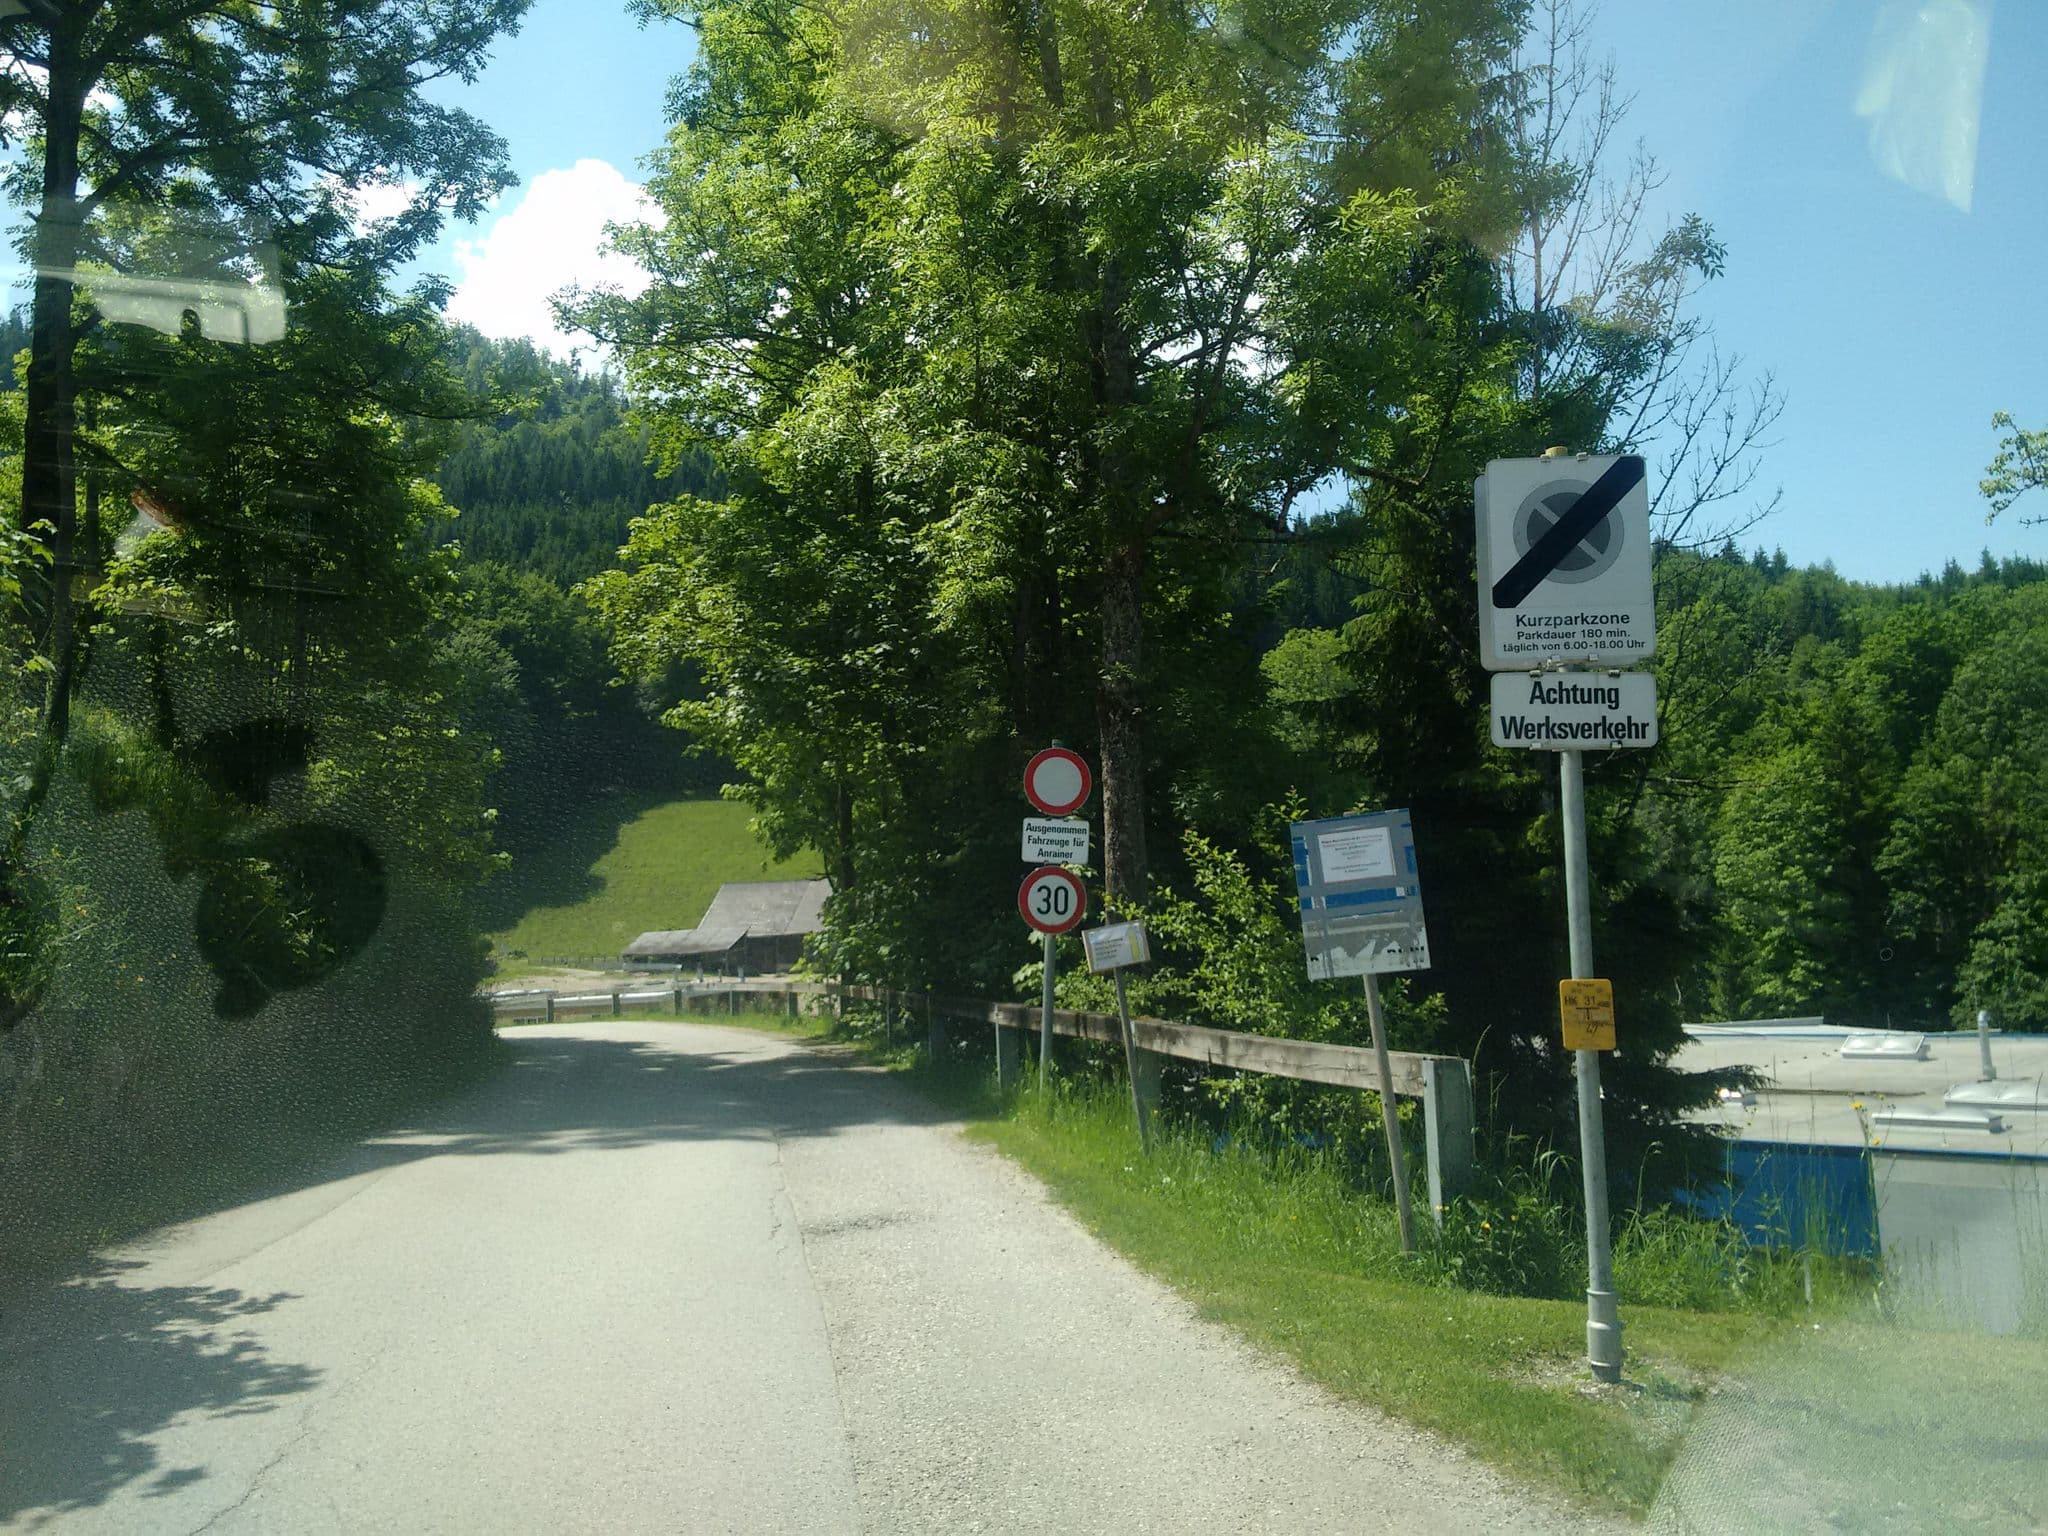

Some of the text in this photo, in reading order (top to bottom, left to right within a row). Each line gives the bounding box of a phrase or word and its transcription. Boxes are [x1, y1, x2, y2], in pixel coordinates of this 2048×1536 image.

[1516, 613, 1630, 628] Kurzparkzone
[1517, 628, 1630, 640] Parkdauer 180 min.
[1503, 643, 1538, 653] täglich
[1563, 640, 1624, 650] 6.00-18.00
[1626, 640, 1645, 648] Uhr
[1529, 681, 1619, 710] Achtung
[1500, 716, 1649, 740] Werksverkehr
[1026, 823, 1087, 835] Ausgenommen
[1027, 835, 1085, 847] Fahrzeuge für
[1037, 848, 1073, 859] Anrainer
[1037, 885, 1069, 915] 30
